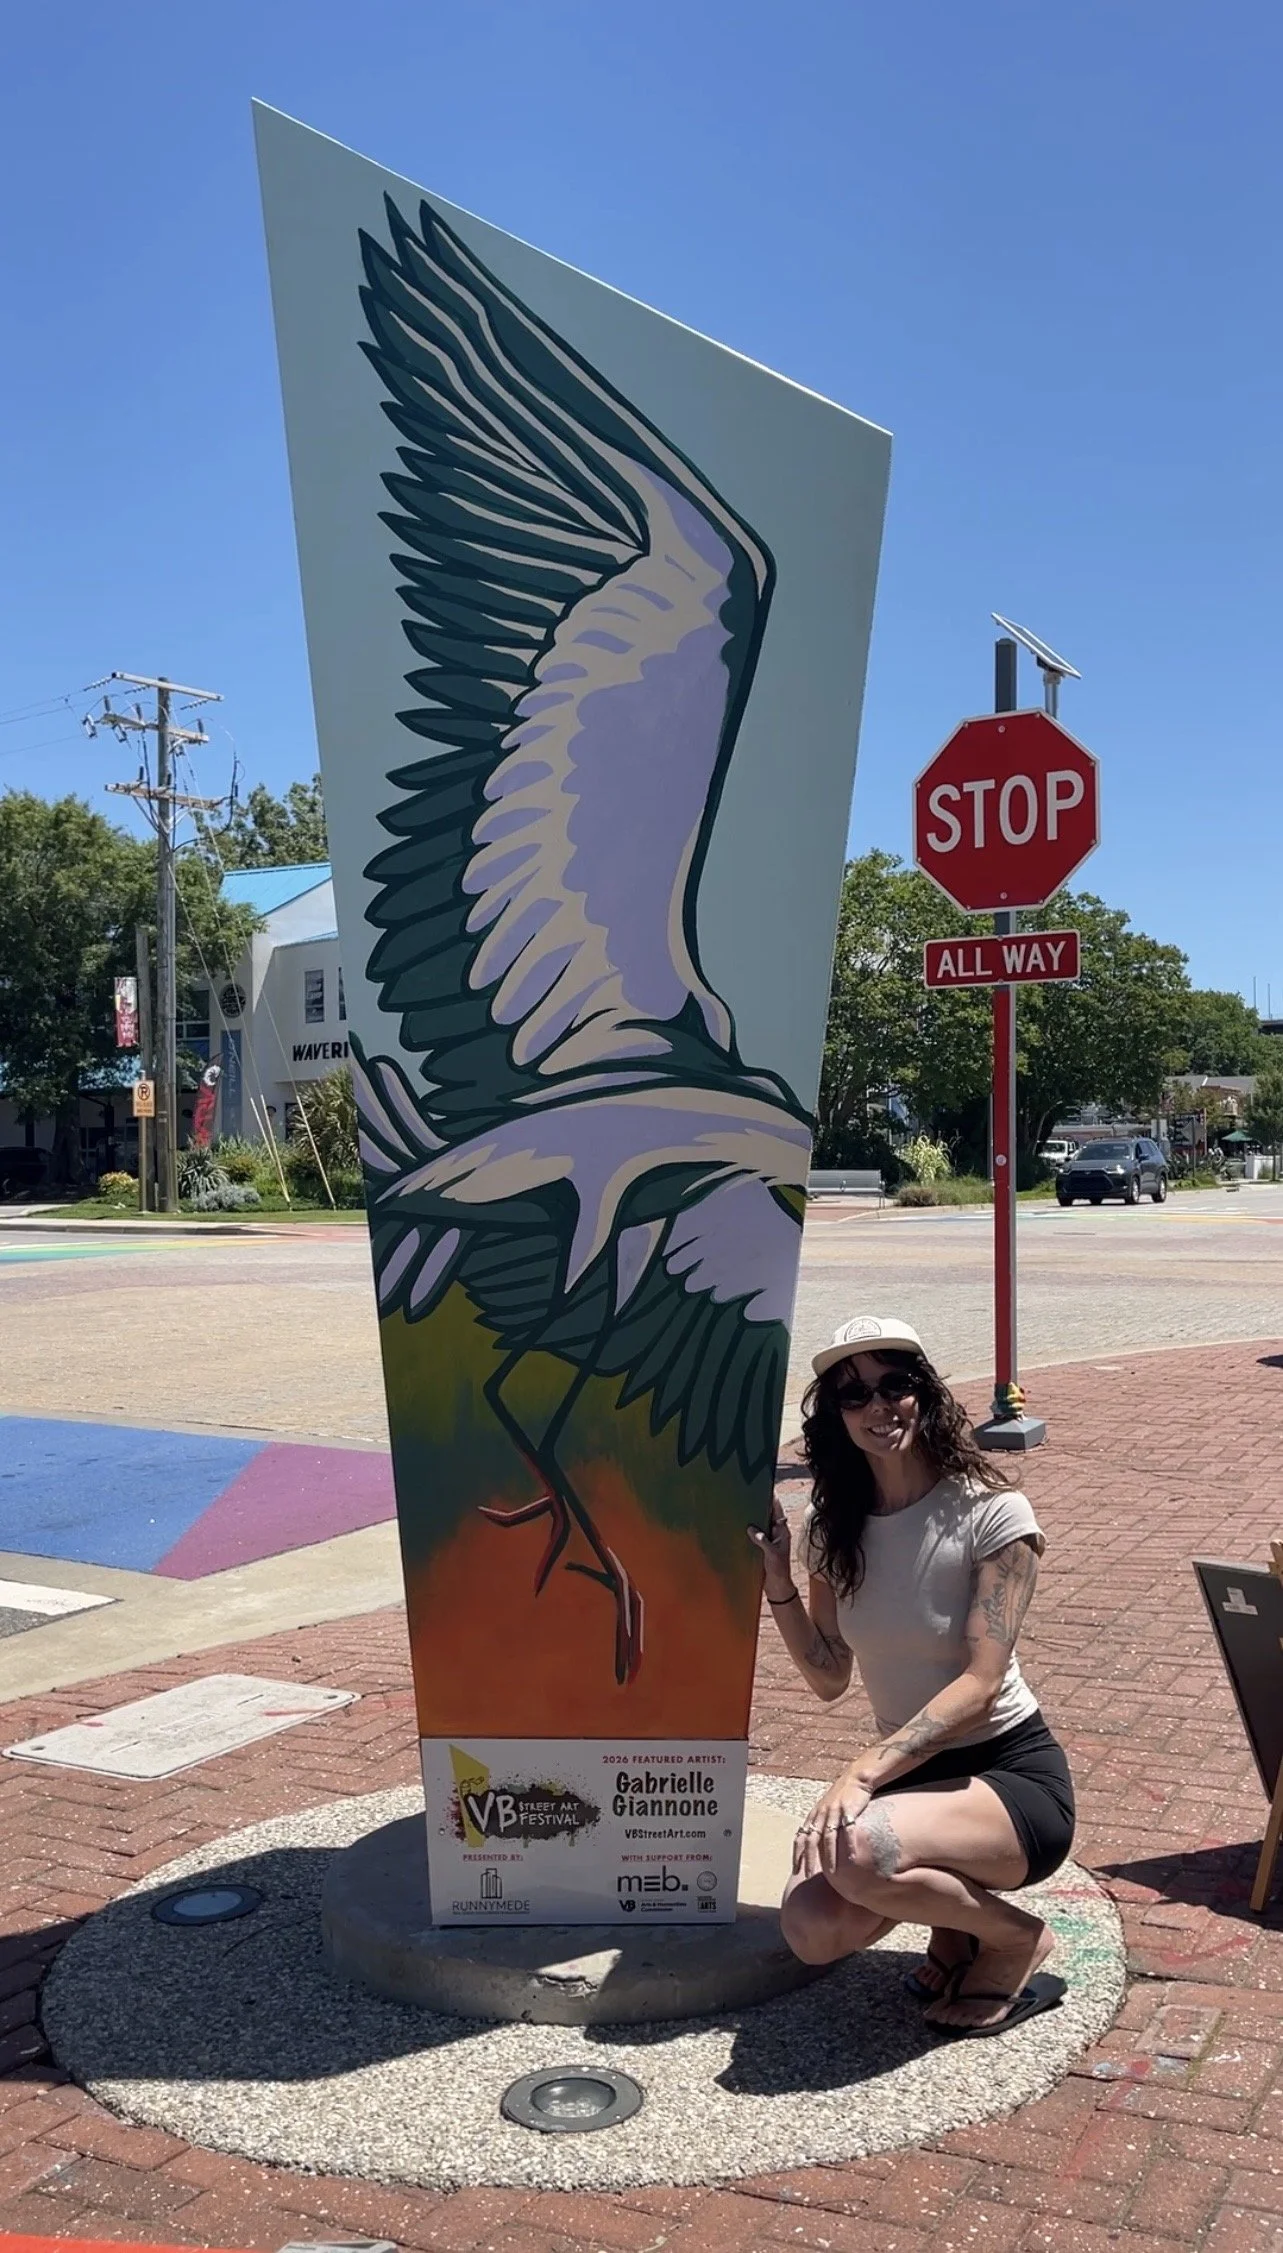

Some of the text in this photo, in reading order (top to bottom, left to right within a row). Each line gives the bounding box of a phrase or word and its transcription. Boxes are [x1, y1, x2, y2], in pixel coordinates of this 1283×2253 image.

[926, 769, 1085, 853] STOP
[937, 940, 1067, 979] ALL WAY
[602, 1755, 726, 1764] 2026 FEATURED ARTIST:
[616, 1771, 715, 1794] Gabrielle
[467, 1791, 518, 1833] VB
[518, 1801, 580, 1812] STREET ART
[612, 1794, 719, 1817] Giannone
[519, 1812, 580, 1826] FESTIVAL
[625, 1828, 706, 1839] VBStreetArt.com
[621, 1854, 712, 1862] WITH SUPPORT FROM:
[452, 1900, 530, 1911] RUNNYMEDE
